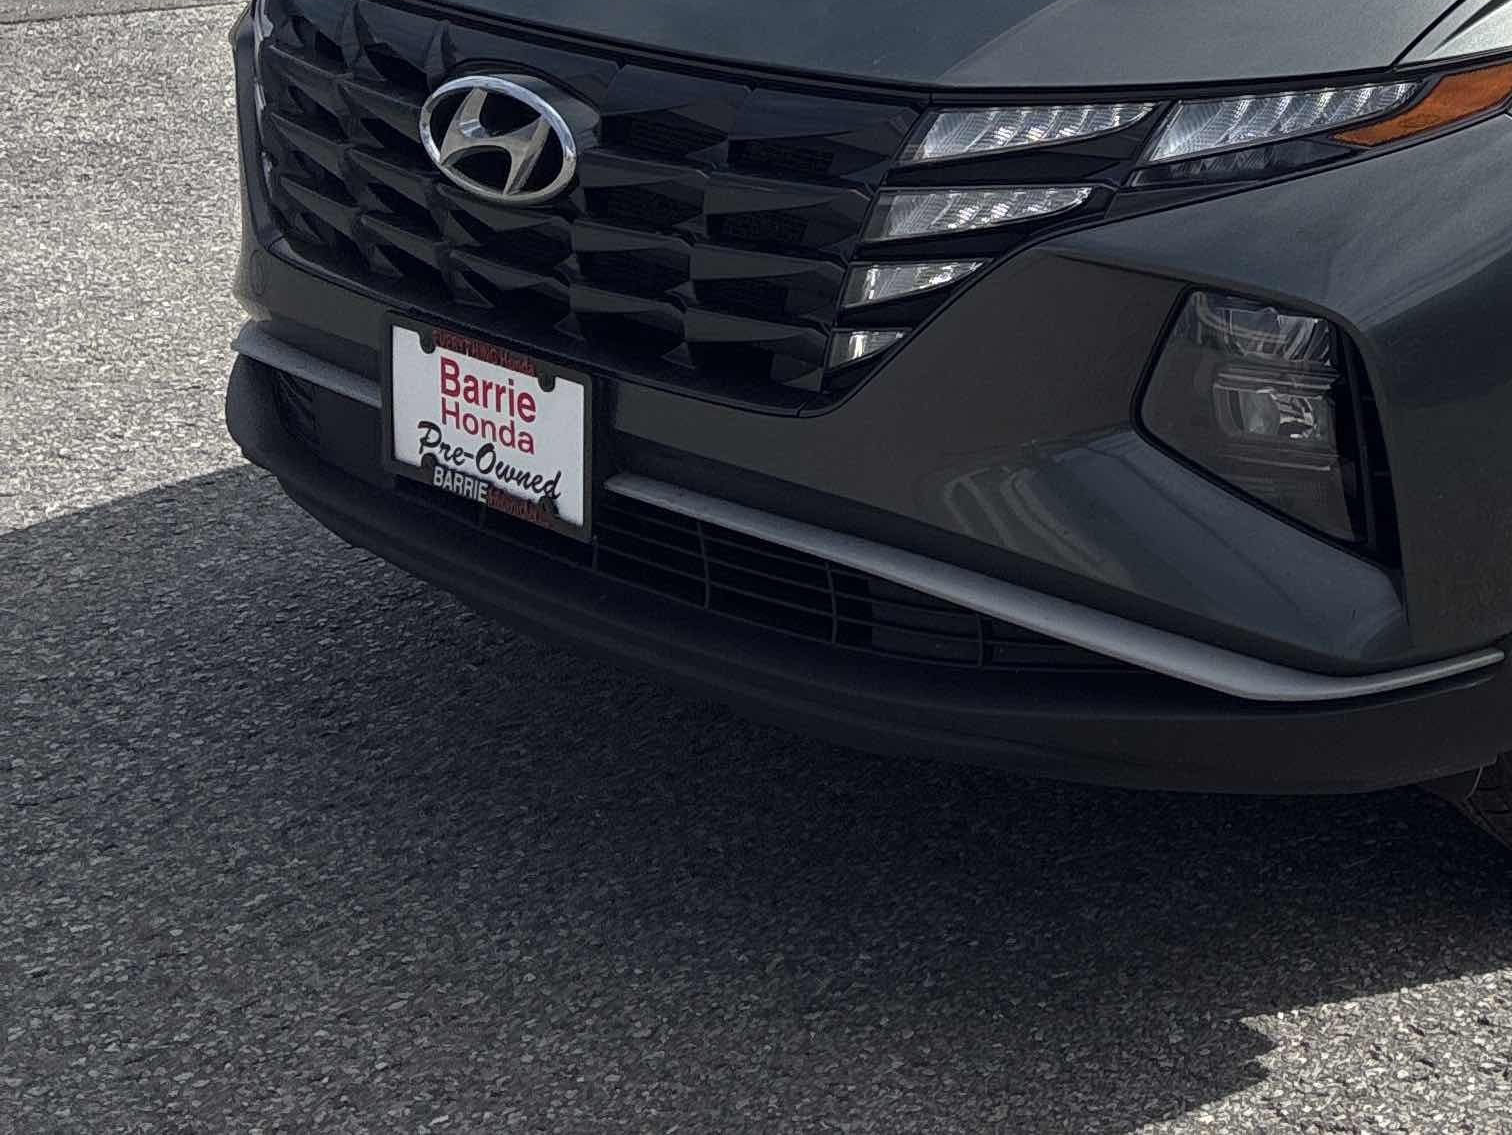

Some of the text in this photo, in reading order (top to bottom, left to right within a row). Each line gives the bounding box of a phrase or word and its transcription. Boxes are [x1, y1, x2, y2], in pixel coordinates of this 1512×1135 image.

[440, 357, 537, 423] Barrie
[441, 397, 535, 455] Honda
[418, 420, 563, 500] Pre-Owned
[433, 466, 489, 504] BARRIE
